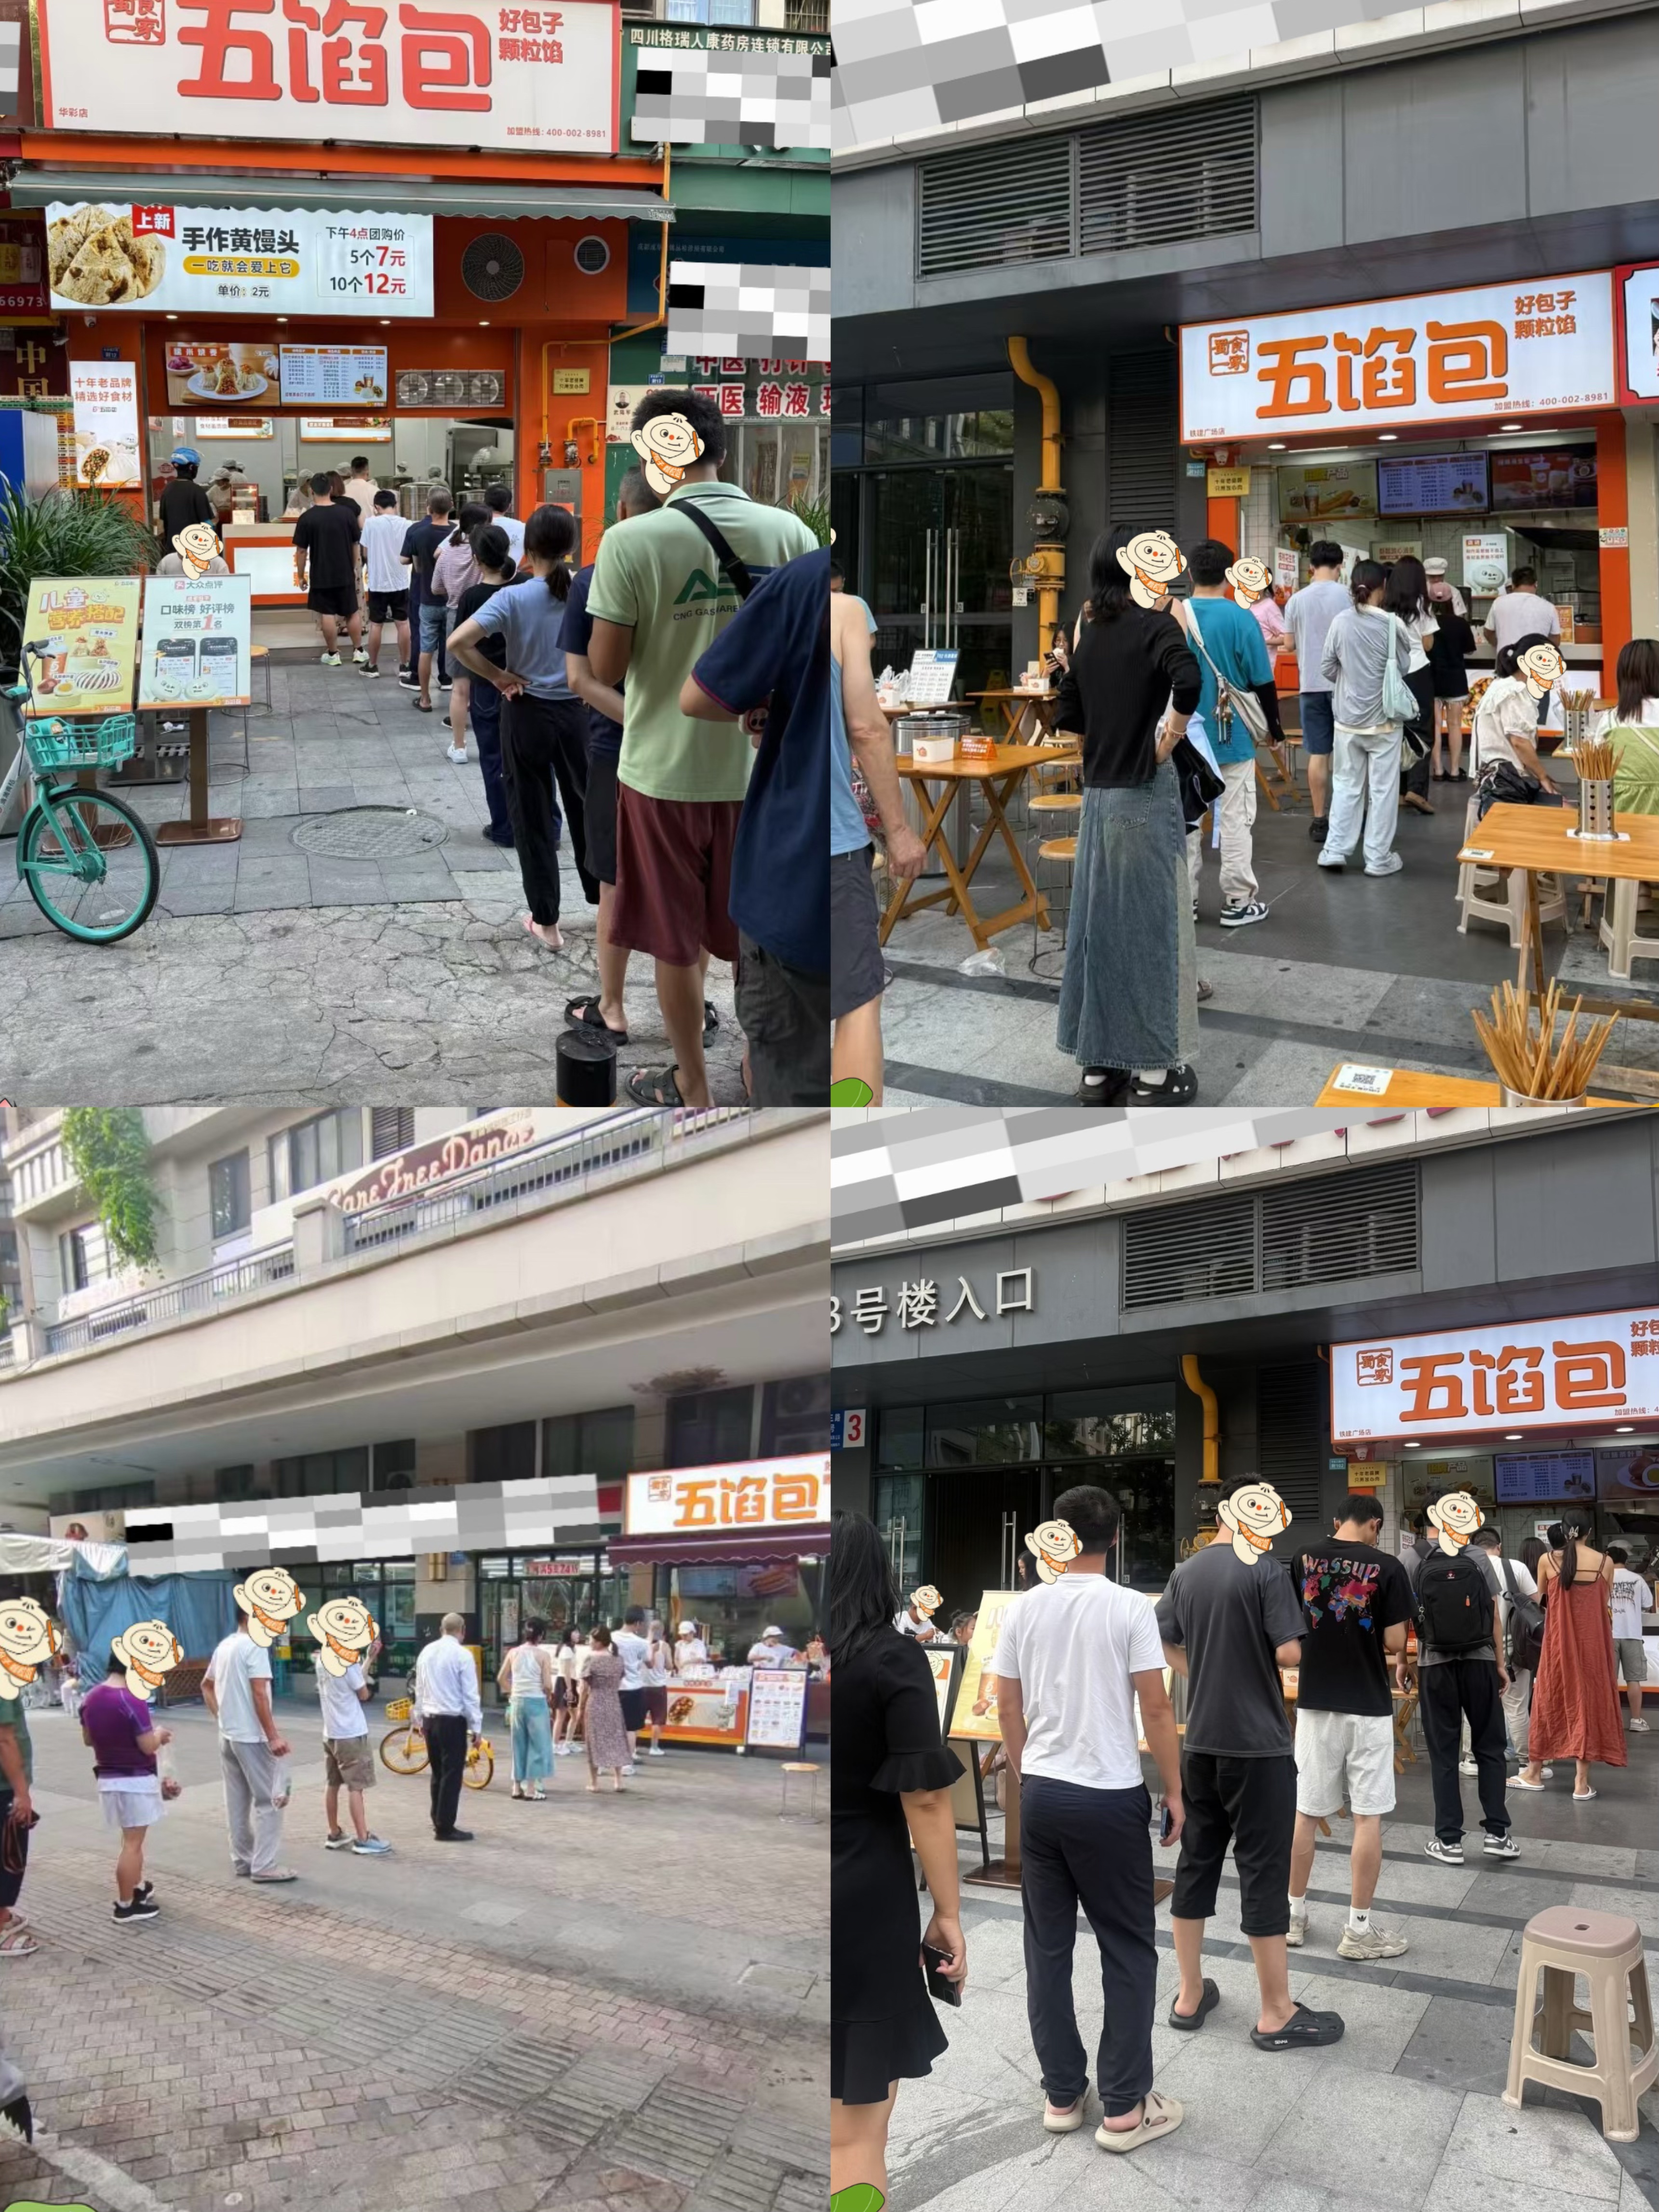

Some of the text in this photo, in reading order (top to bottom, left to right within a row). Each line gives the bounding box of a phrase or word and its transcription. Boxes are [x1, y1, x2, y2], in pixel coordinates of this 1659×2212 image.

[498, 9, 564, 35] 好包子
[177, 0, 492, 112] 五馅包
[498, 37, 563, 64] 颗粒馅
[58, 107, 88, 118] 华彩店
[136, 213, 171, 231] 上新
[325, 227, 405, 241] 下午4点团购价
[182, 227, 300, 254] 手作黄馒头
[191, 259, 292, 275] 一吃就会爱上它
[350, 246, 406, 267] 5个7元
[330, 273, 406, 295] 10个12元
[1514, 291, 1577, 316] 好包子
[1514, 314, 1577, 339] 颗粒馅
[1256, 320, 1508, 419] 五馅包
[75, 378, 132, 388] 十年老品牌
[75, 391, 133, 401] 精选好食材
[757, 382, 810, 416] 输液
[186, 581, 223, 589] 大众点评
[39, 586, 89, 613] 儿童
[161, 603, 235, 615] 口味榜 好评榜
[48, 604, 126, 631] 营养搭配
[174, 614, 222, 630] 双榜第1名
[673, 610, 693, 621] CNG
[830, 1266, 1034, 1333] 3号楼入口
[1399, 1340, 1627, 1422] 五馅包
[847, 1413, 862, 1441] 3
[1339, 1429, 1372, 1437] 铁建广场店
[674, 1473, 819, 1527] 五馅包
